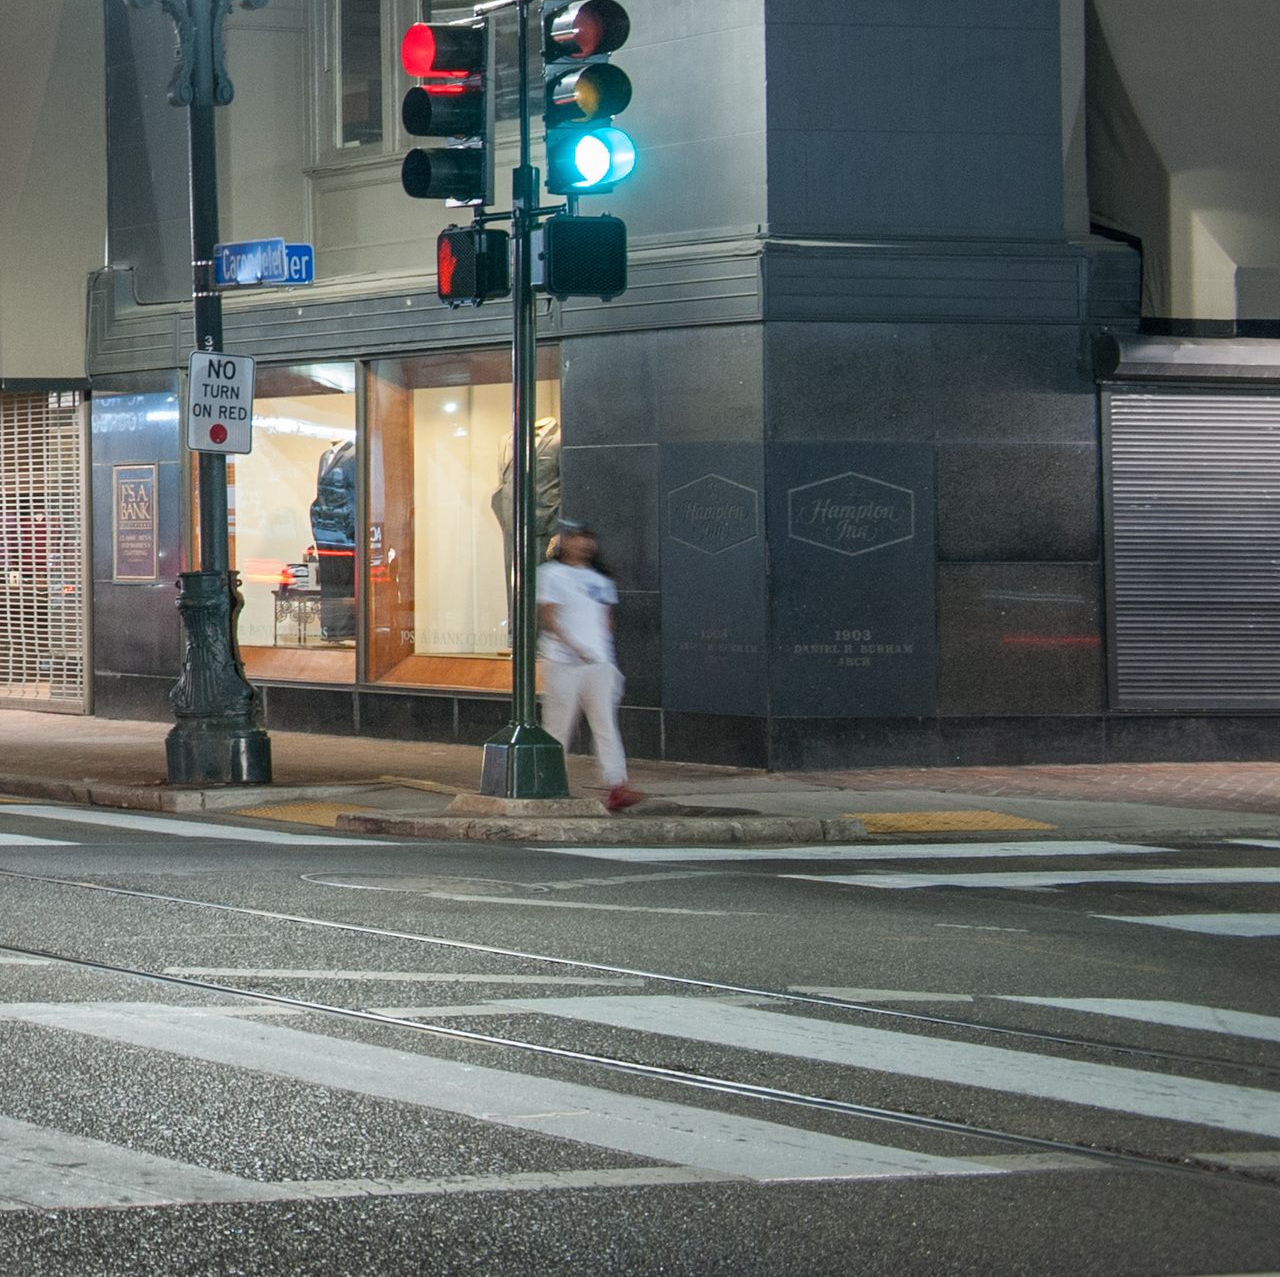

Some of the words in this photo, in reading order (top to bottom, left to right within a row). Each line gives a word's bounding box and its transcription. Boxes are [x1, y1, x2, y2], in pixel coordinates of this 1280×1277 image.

[222, 245, 283, 279] Carondelet
[208, 359, 236, 380] NO
[202, 383, 240, 400] TURN
[193, 403, 212, 418] ON
[218, 405, 247, 420] RED
[121, 502, 151, 520] BANK
[801, 497, 898, 524] Hampton
[834, 629, 872, 642] 1903
